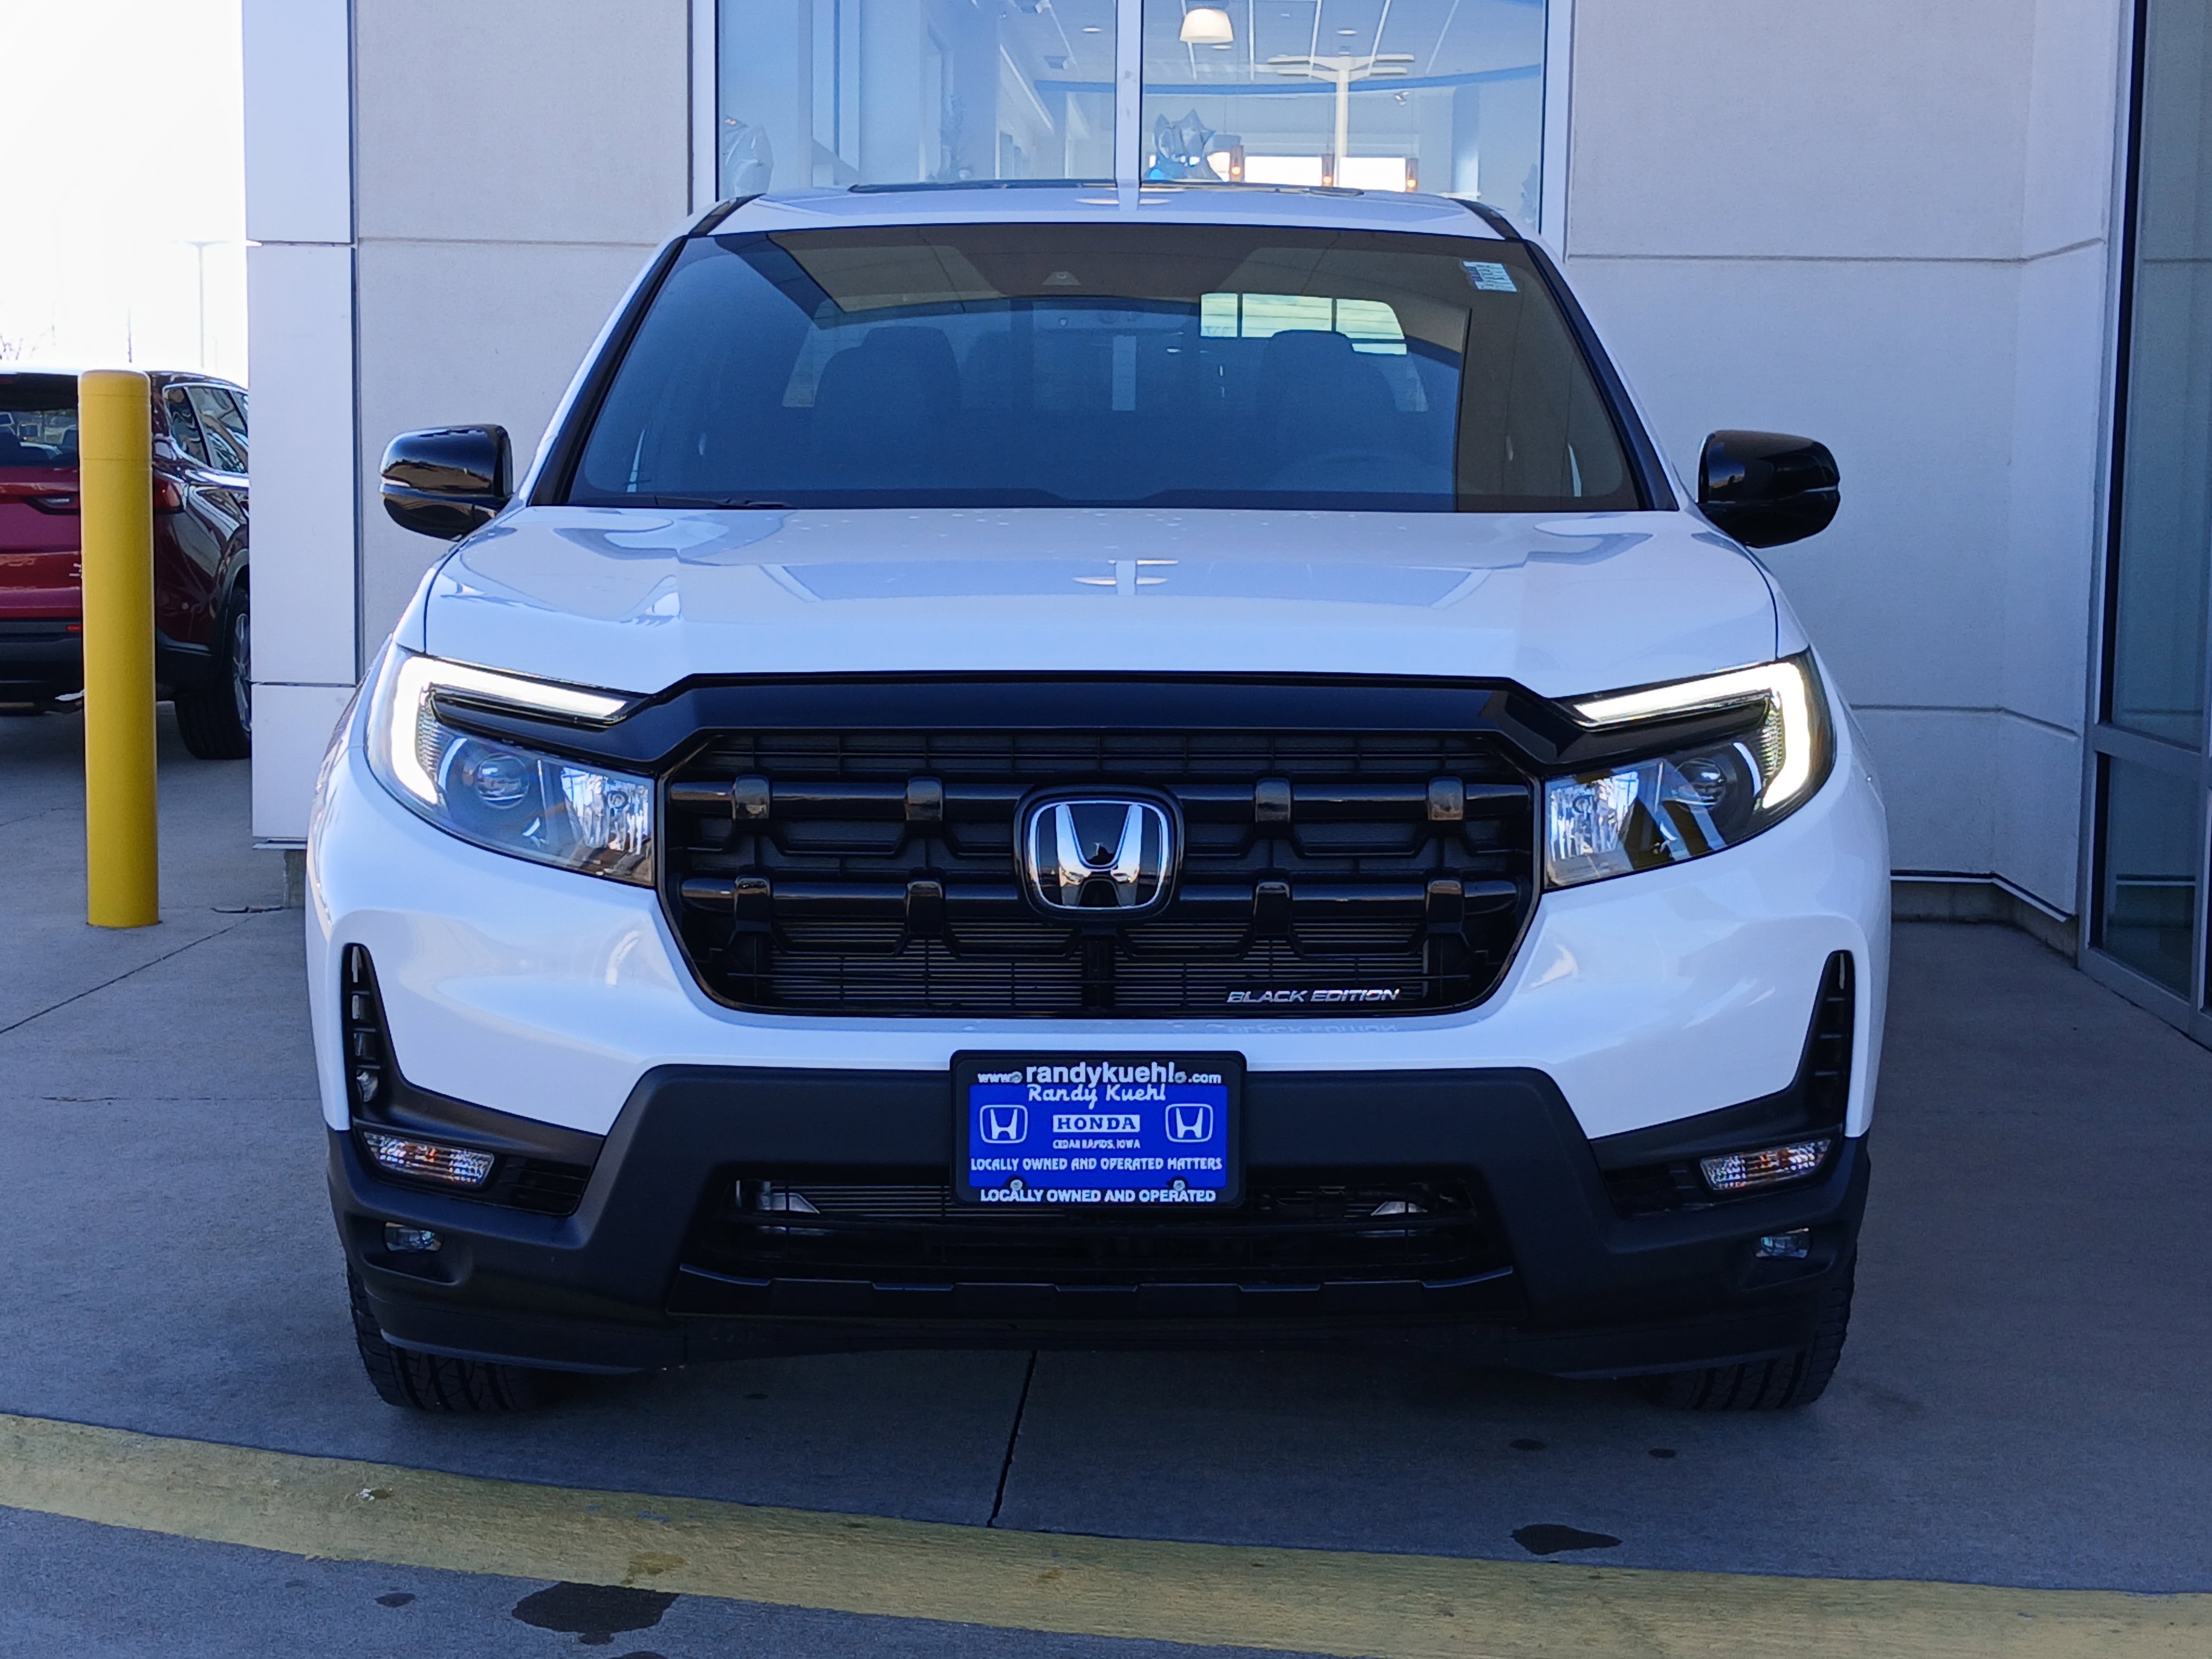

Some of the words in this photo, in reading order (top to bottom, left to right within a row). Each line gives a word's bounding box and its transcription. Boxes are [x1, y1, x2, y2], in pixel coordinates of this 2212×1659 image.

[1227, 991, 1308, 1002] BLACK
[1310, 989, 1400, 1001] EDITION
[1027, 1084, 1098, 1110] Randy
[1105, 1084, 1166, 1101] Kuehl
[1057, 1117, 1136, 1130] HONDA
[1117, 1139, 1141, 1149] IOWA
[970, 1158, 1019, 1171] LOCALLY
[1023, 1158, 1068, 1170] OWNED
[1071, 1158, 1097, 1170] AND
[1100, 1158, 1164, 1170] OPERATED
[1167, 1158, 1223, 1170] MATTERS
[980, 1189, 1044, 1202] LOCALLY
[1046, 1190, 1101, 1202] OWNED
[1104, 1190, 1135, 1202] AND
[1139, 1189, 1216, 1202] OPERATED
